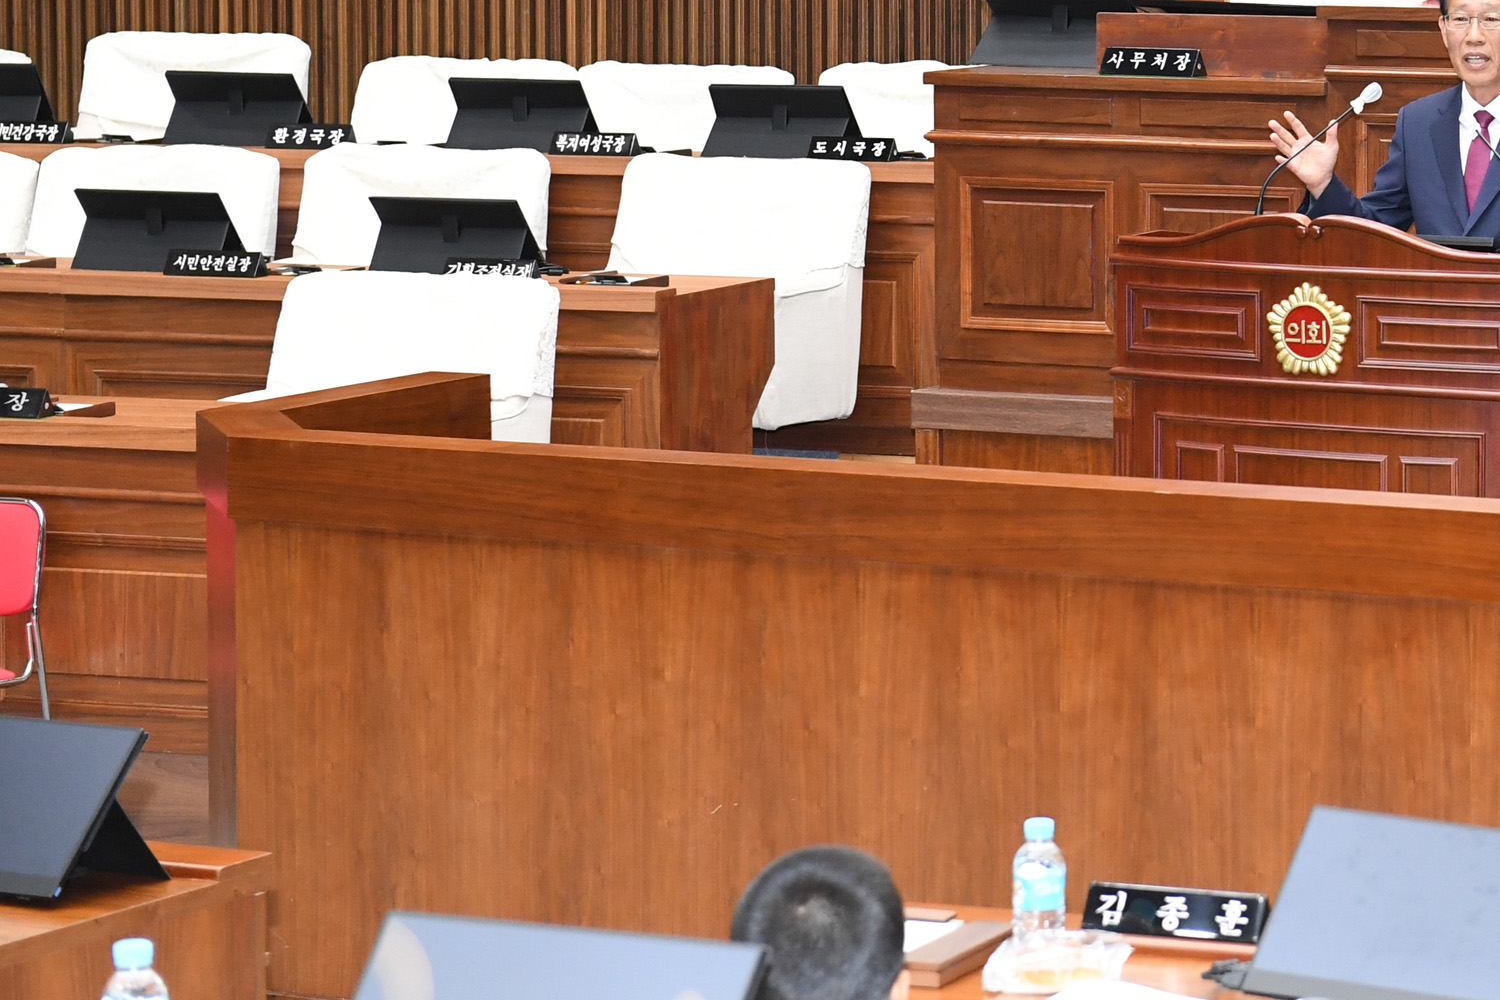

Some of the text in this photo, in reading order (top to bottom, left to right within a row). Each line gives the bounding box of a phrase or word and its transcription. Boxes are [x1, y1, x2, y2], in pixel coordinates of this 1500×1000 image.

[1106, 50, 1192, 71] 사무처장
[272, 127, 345, 145] 환경국장
[555, 133, 626, 153] 복지여성국장
[812, 140, 887, 157] 도시국장
[173, 253, 252, 272] 시민안전실장
[1285, 319, 1327, 345] 의회
[1095, 890, 1249, 937] 김종훈
